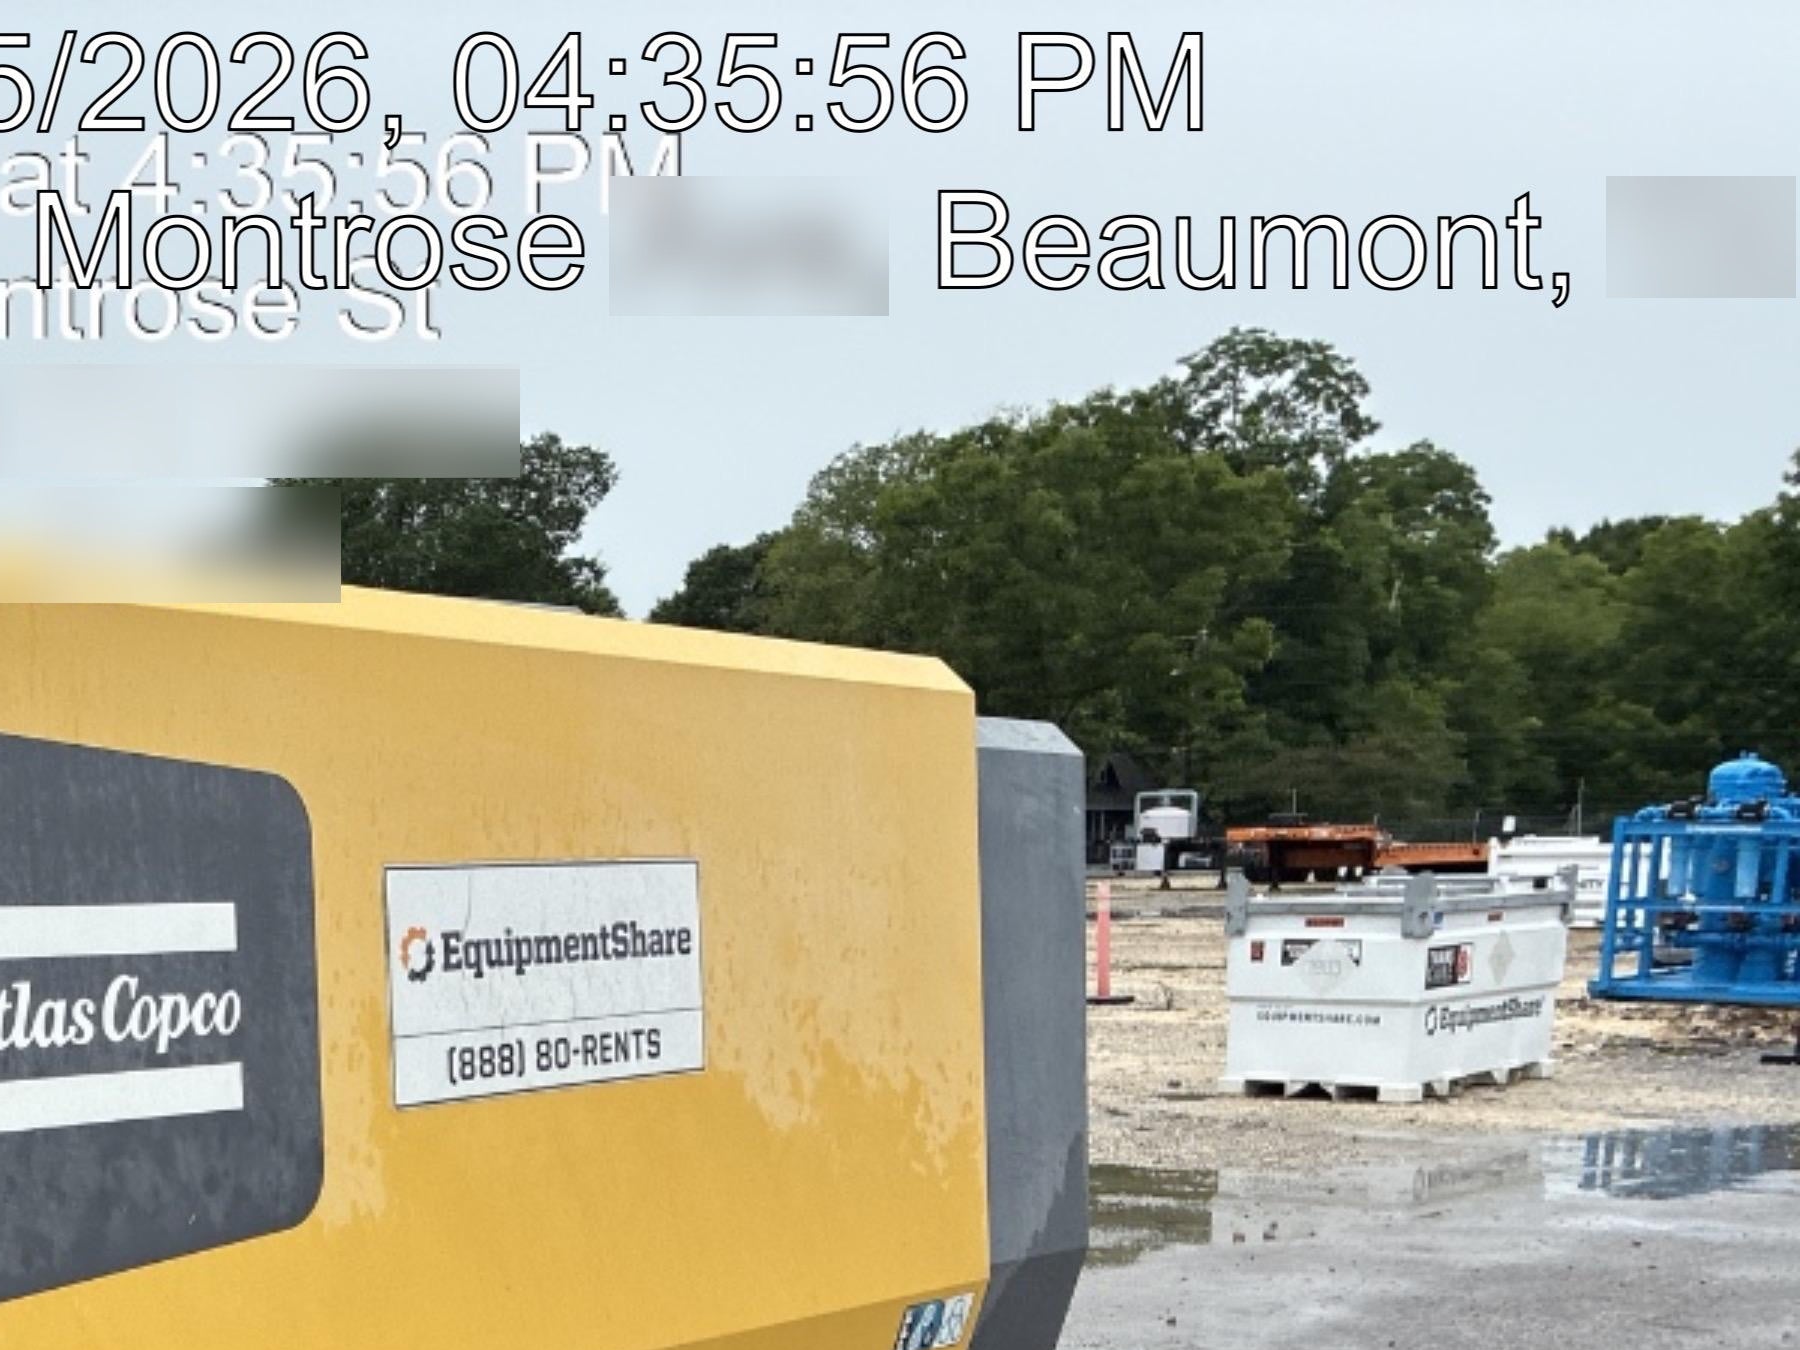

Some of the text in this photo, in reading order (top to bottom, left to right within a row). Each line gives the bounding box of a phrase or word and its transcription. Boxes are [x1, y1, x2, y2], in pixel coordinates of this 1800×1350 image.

[440, 920, 692, 979] EquipmentShare
[101, 974, 241, 1054] Copco
[448, 1028, 662, 1086] (888) 80-RENTS
